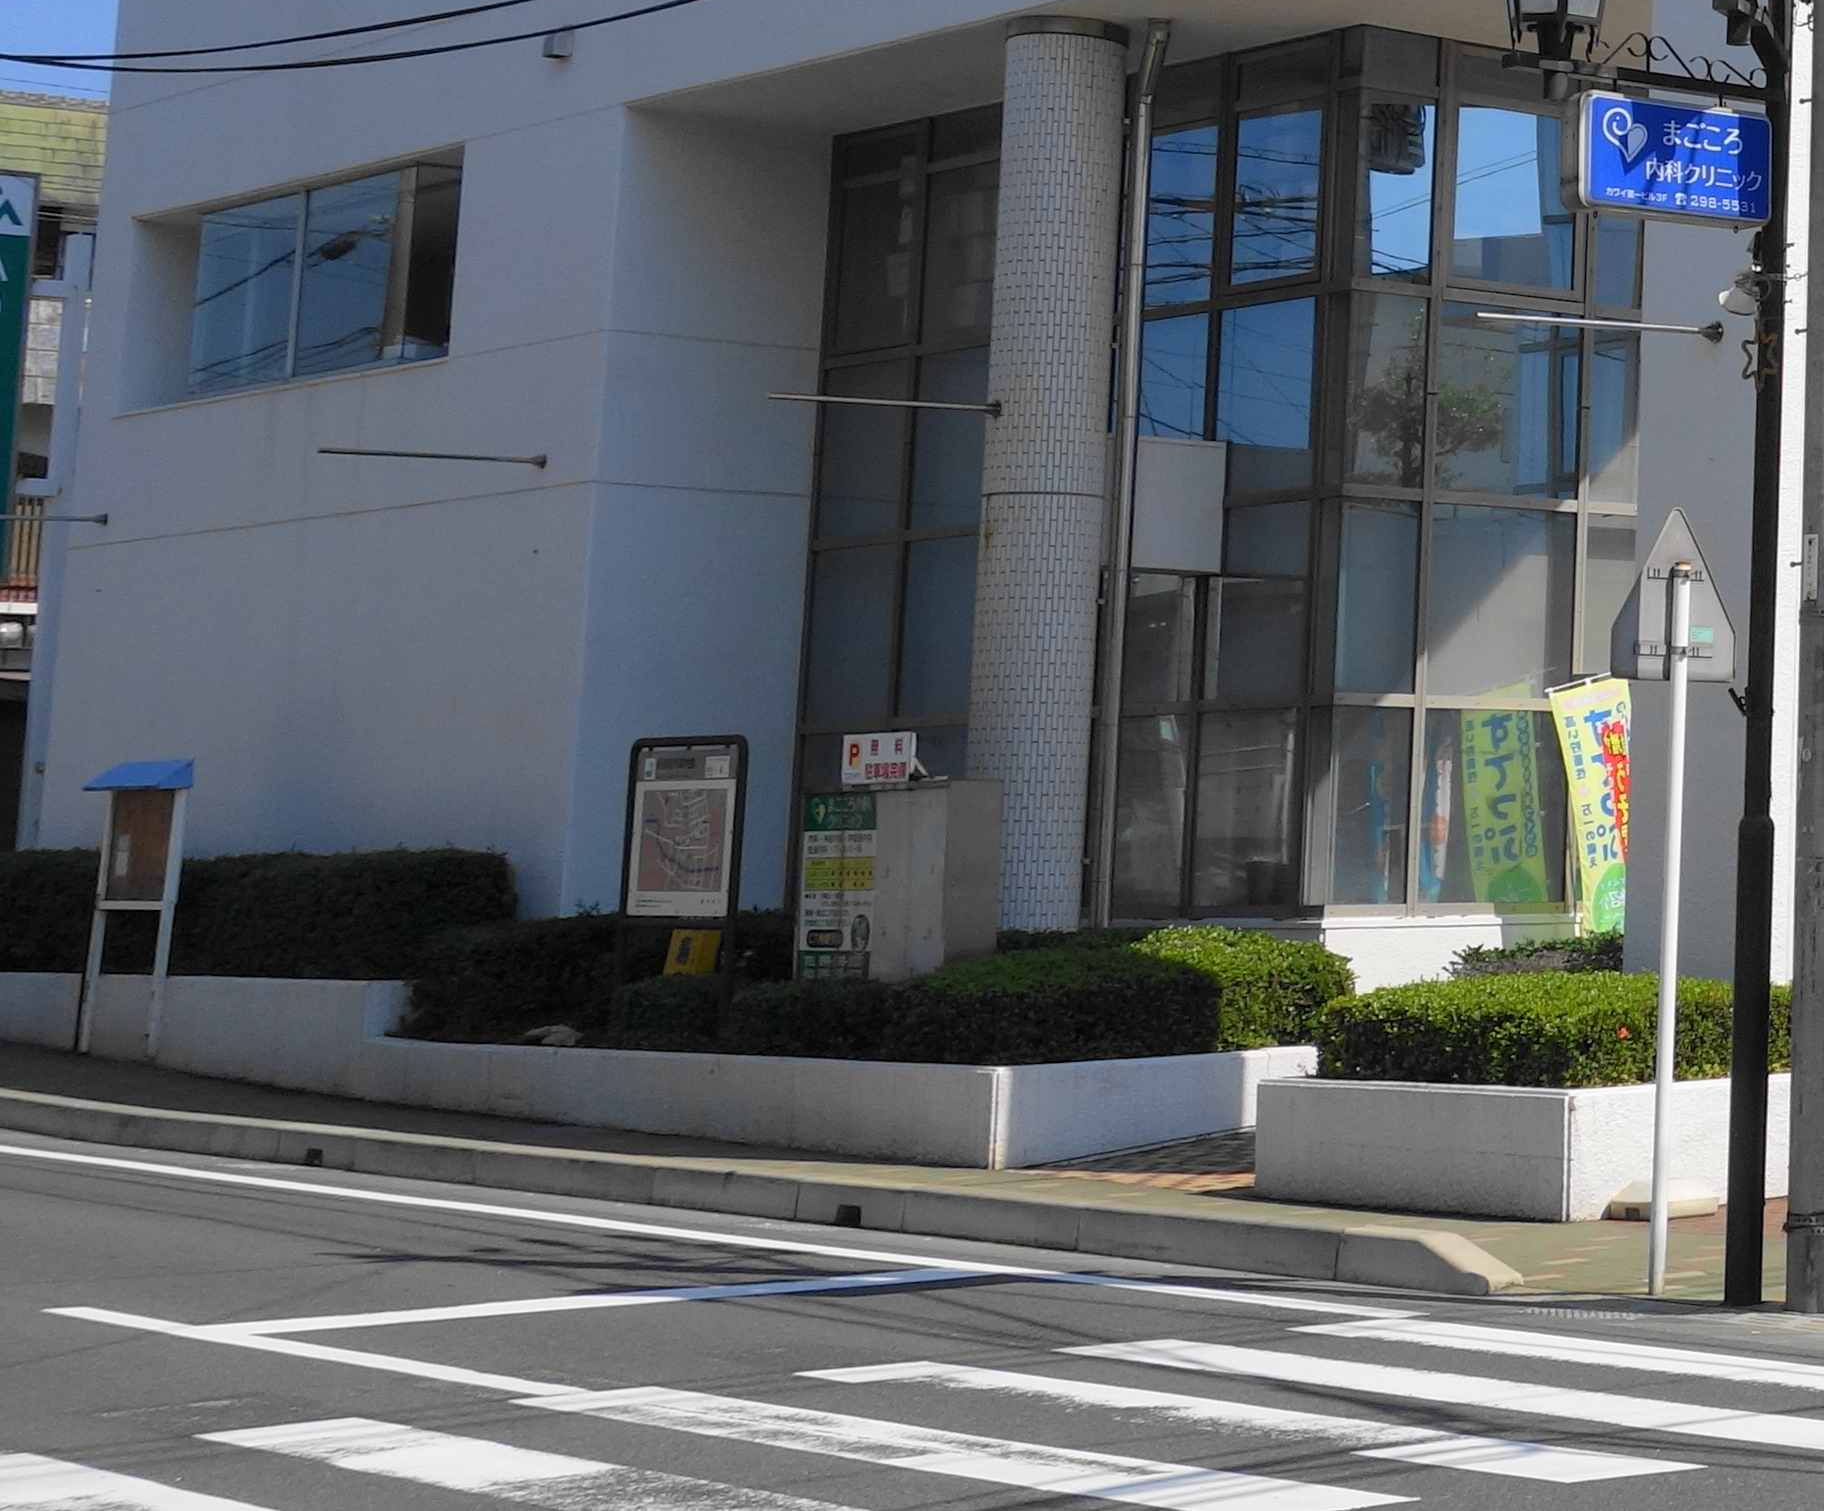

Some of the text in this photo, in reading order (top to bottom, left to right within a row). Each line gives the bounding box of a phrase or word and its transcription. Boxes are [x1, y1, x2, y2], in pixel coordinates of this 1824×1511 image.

[1661, 119, 1743, 156] まごころ
[1645, 159, 1762, 192] 内科クリニック
[847, 743, 860, 767] P
